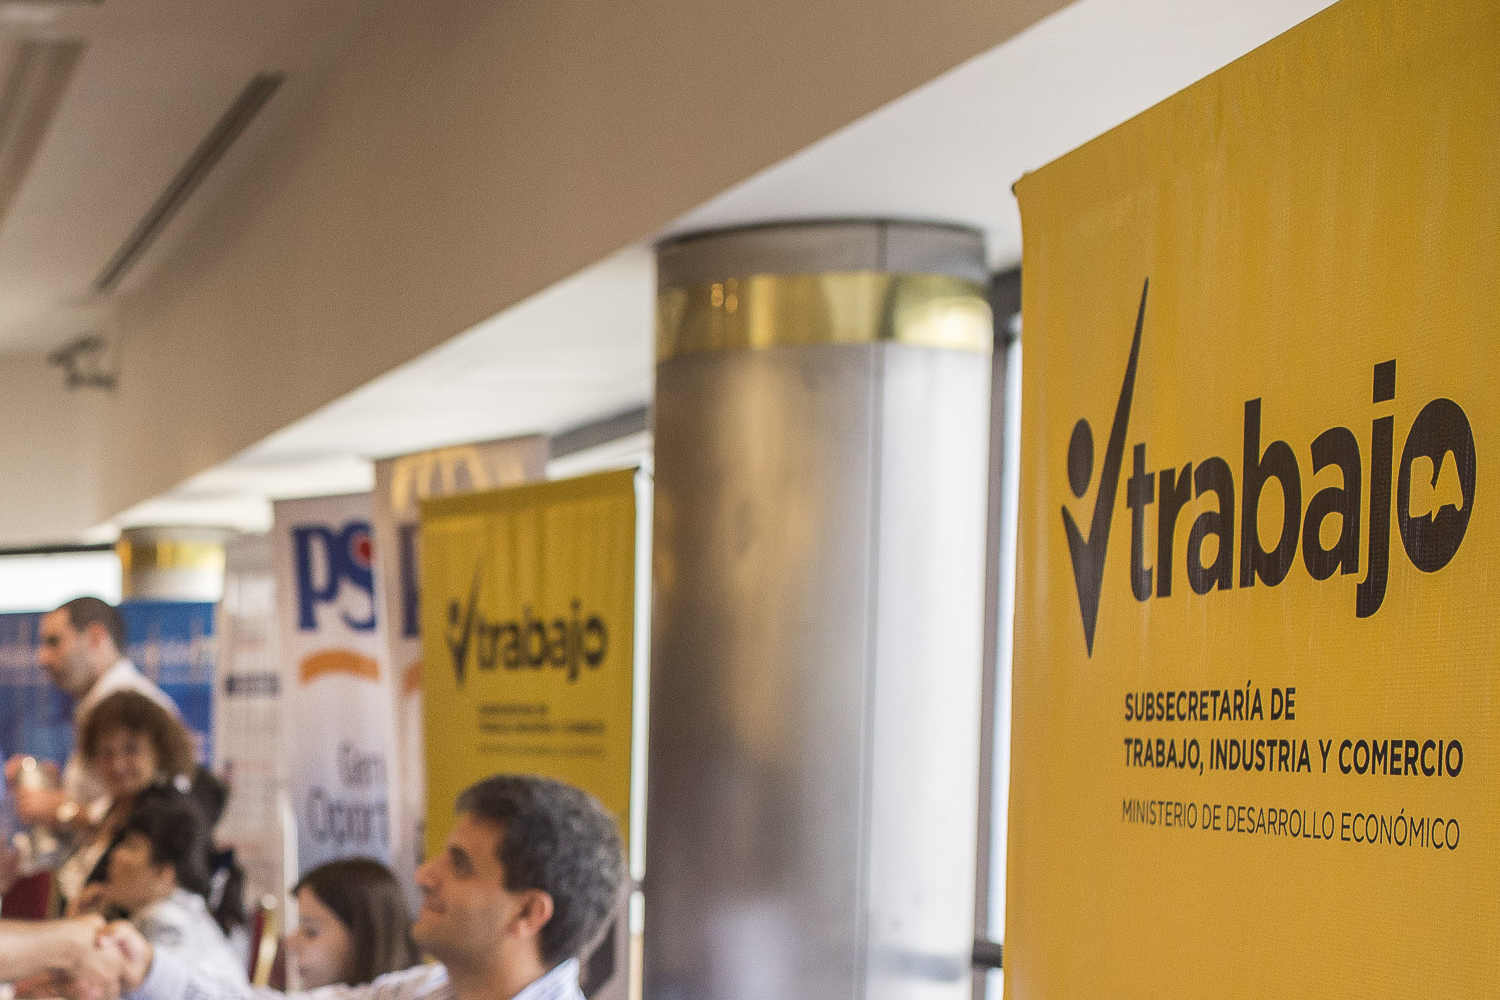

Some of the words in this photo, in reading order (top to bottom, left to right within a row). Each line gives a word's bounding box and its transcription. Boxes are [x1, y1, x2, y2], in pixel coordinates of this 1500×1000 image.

[1127, 358, 1477, 619] trabajo
[477, 597, 609, 684] trabajo
[1124, 679, 1264, 721] SUBSECRETARÍA
[1270, 687, 1296, 721] DE
[1124, 737, 1204, 777] TRABAJO,
[1209, 738, 1312, 773] INDUSTRIA
[1317, 739, 1333, 774] Y
[1338, 739, 1464, 778] COMERCIO
[1121, 799, 1198, 830] MINISTERIO
[1202, 803, 1222, 831] DE
[1226, 805, 1335, 841] DESARROLLO
[1340, 807, 1461, 851] ECONÓMICO
